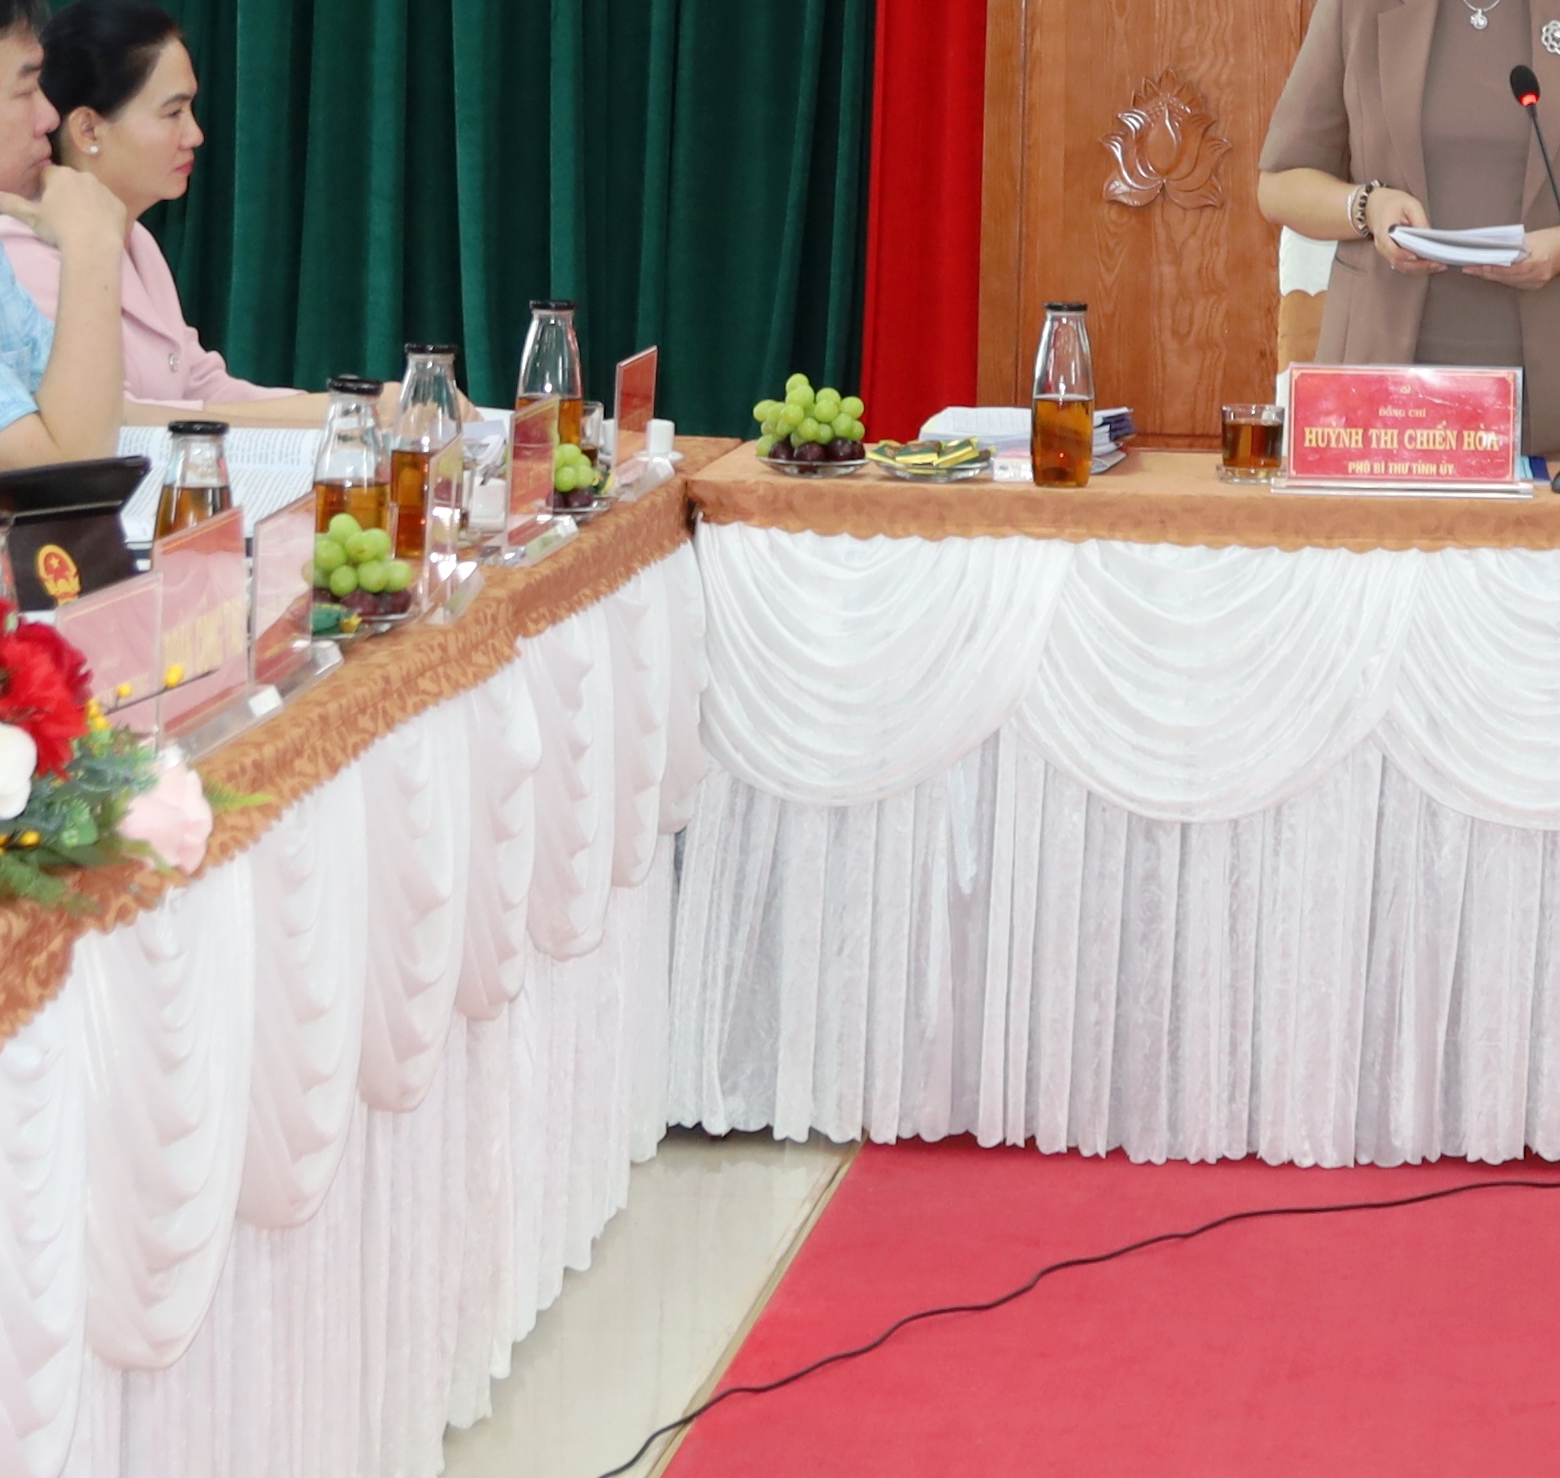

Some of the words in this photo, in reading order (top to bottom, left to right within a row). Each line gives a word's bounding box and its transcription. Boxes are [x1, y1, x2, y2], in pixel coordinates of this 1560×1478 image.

[1408, 408, 1427, 418] CHÍ
[1304, 421, 1364, 448] HUỲNH
[1369, 428, 1399, 454] THỊ
[1462, 423, 1500, 452] HÒA
[1347, 459, 1371, 474] PHÓ
[1373, 460, 1386, 475] BÍ
[1387, 462, 1410, 475] THƯ
[1412, 459, 1437, 475] TỈNH
